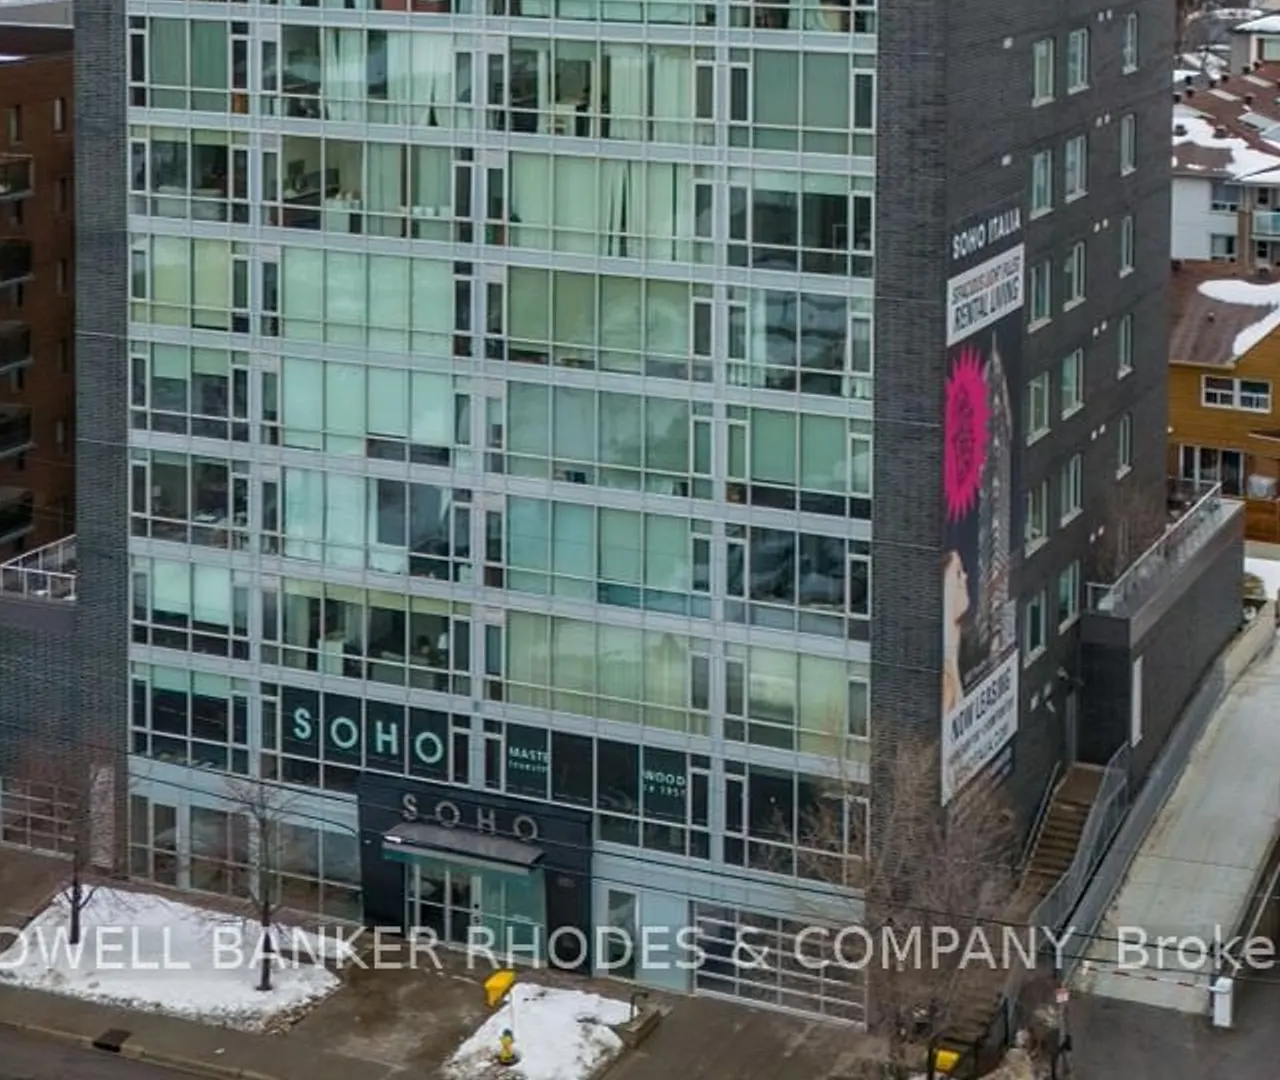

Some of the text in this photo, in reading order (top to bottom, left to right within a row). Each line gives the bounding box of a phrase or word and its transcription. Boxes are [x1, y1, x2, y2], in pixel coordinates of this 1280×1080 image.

[952, 206, 1020, 260] SOHO ITALIA
[953, 275, 1019, 331] RENTAL LIVING
[951, 704, 973, 740] NOW
[975, 666, 1011, 719] LEASING
[293, 707, 444, 764] SOHO
[402, 793, 539, 841] SOHO
